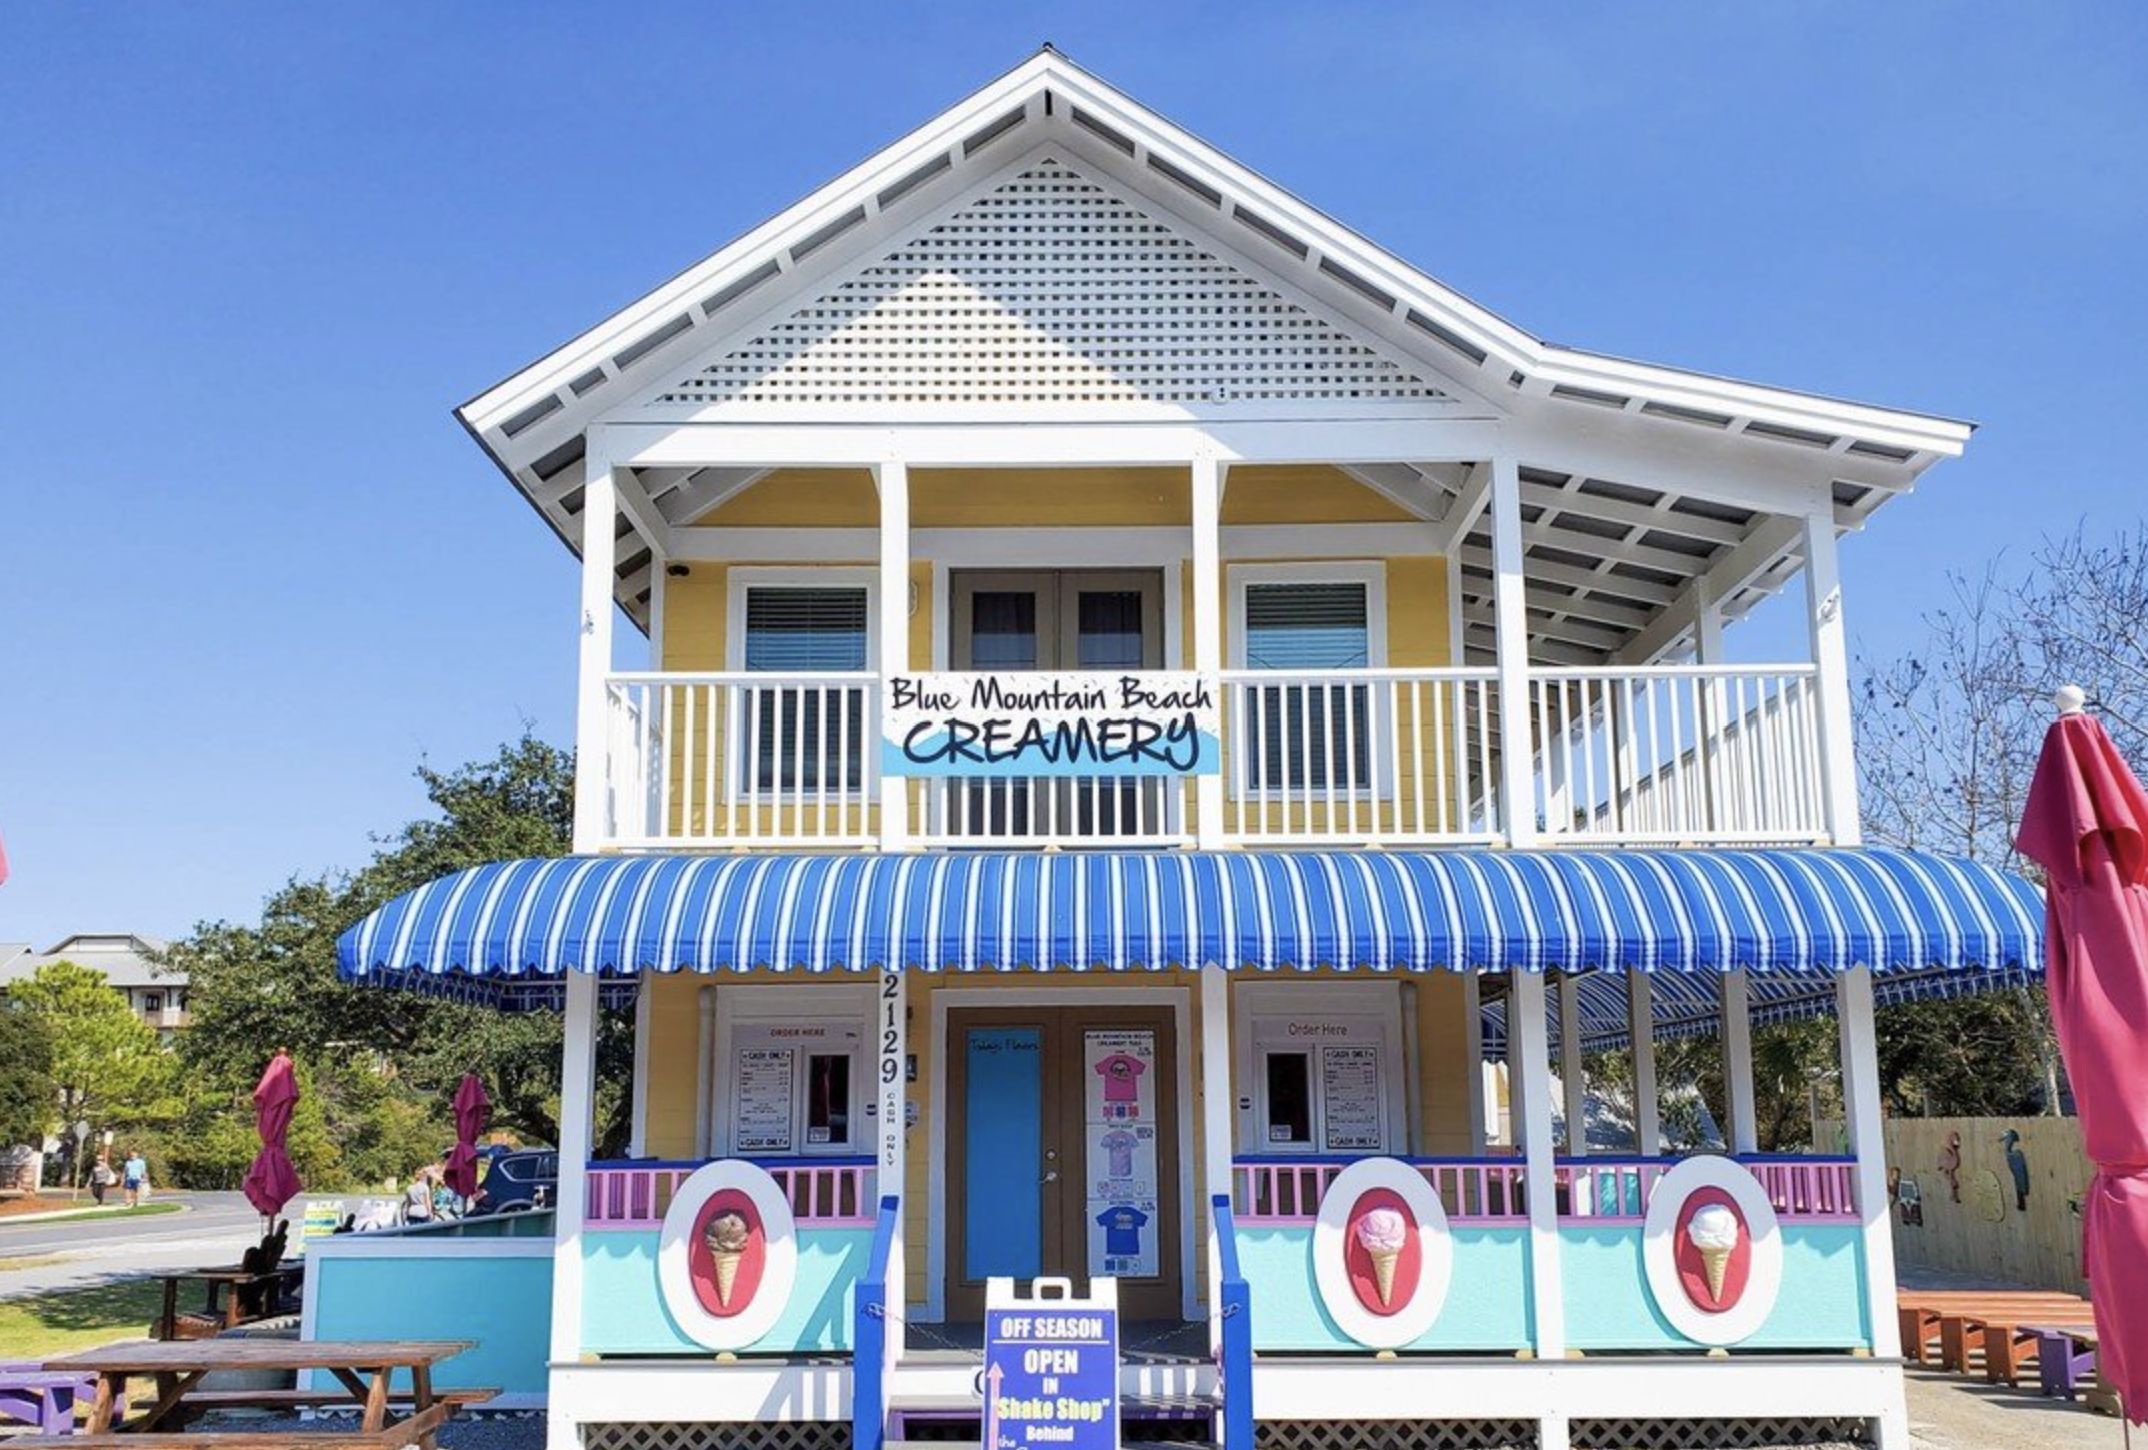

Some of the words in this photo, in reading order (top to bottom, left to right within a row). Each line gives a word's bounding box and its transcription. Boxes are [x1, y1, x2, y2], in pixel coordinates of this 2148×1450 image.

[890, 676, 959, 711] Blue
[971, 675, 1107, 711] Mountain
[1119, 675, 1213, 711] Beach
[903, 711, 1200, 772] CREAMERY
[802, 1028, 825, 1038] HERE
[882, 974, 898, 1084] 2129
[1288, 1022, 1320, 1036] Order
[1322, 1023, 1348, 1036] Here
[1001, 1317, 1032, 1338] OFF
[1034, 1317, 1102, 1338] SEASON
[1024, 1349, 1078, 1374] OPEN
[1043, 1377, 1058, 1395] IN
[999, 1434, 1017, 1448] the
[1026, 1425, 1074, 1441] Behind
